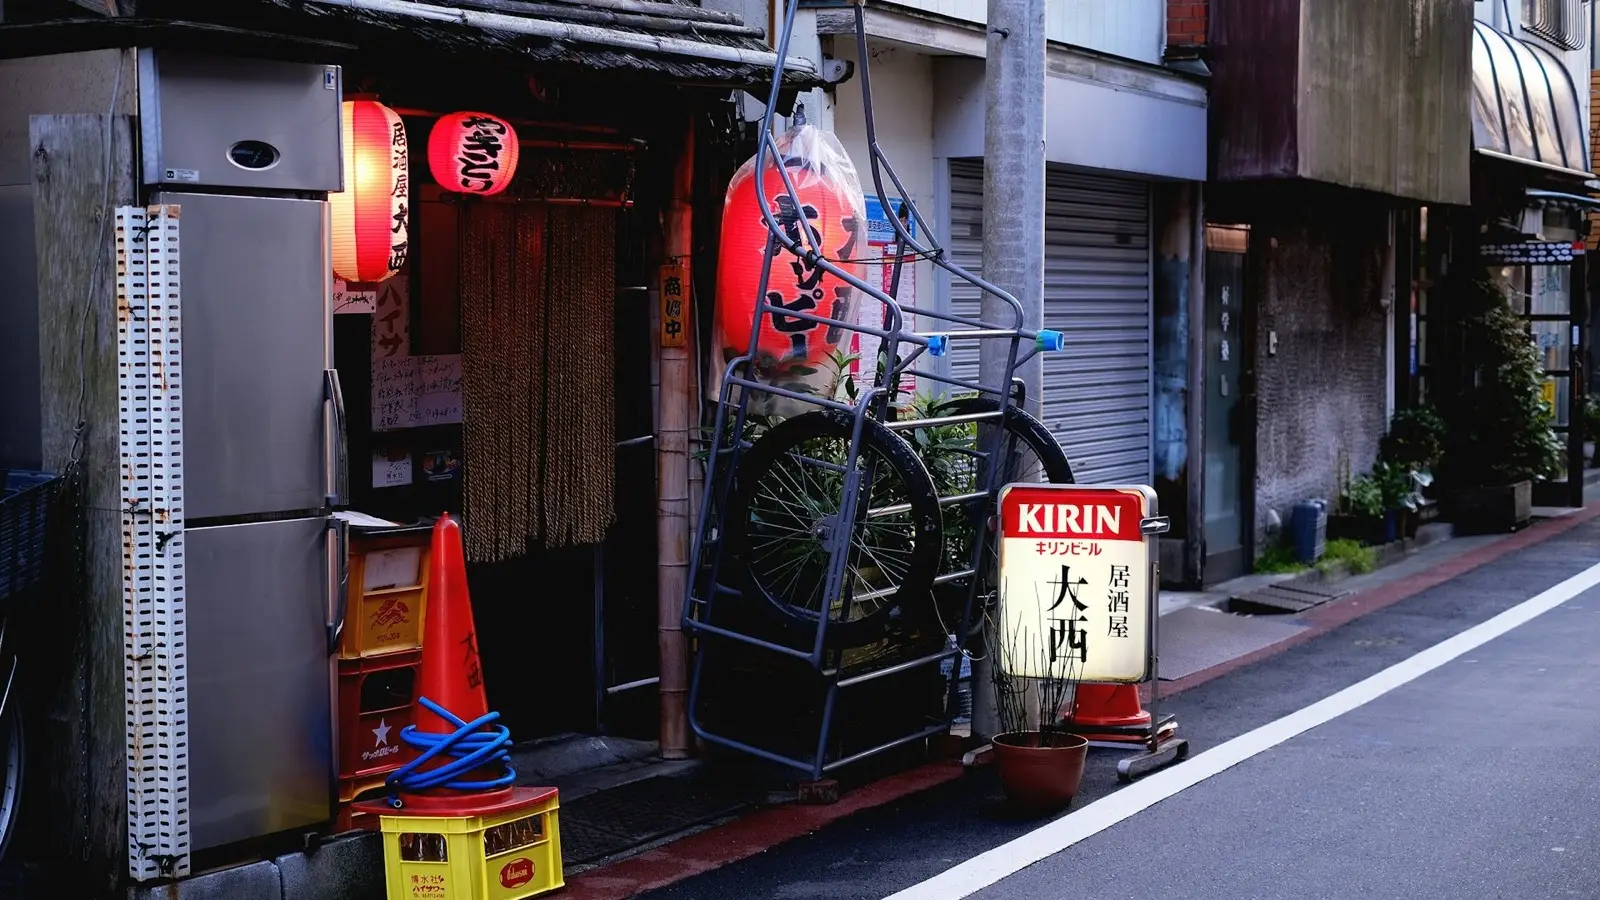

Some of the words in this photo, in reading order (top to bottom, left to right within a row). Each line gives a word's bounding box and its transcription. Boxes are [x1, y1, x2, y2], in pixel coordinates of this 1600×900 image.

[458, 116, 507, 192] やきとり
[1018, 503, 1122, 534] KIRIN
[1035, 541, 1102, 556] キリンビール
[1046, 564, 1089, 663] 大西
[1107, 564, 1131, 639] 居酒屋
[412, 884, 445, 892] ハイサワー
